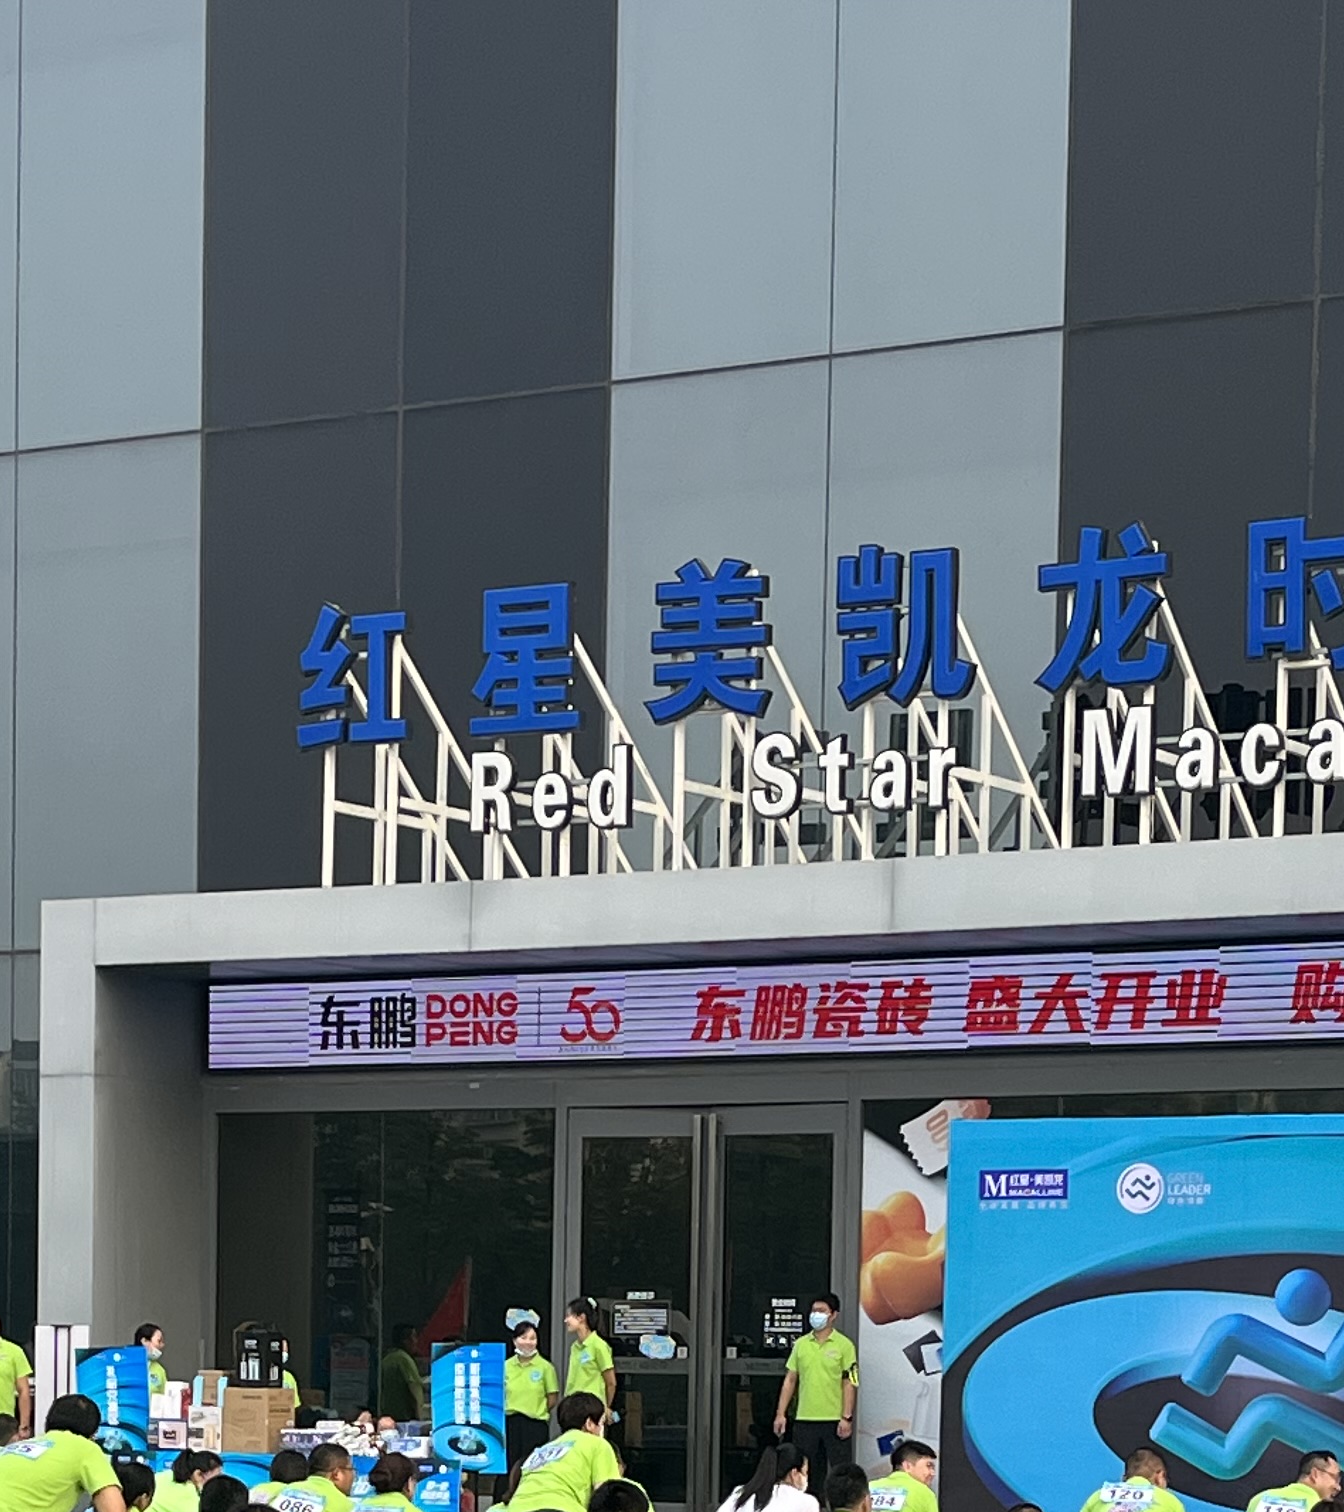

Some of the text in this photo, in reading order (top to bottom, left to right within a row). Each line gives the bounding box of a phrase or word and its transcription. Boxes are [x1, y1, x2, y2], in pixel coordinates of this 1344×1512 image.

[469, 742, 634, 836] Red
[750, 729, 960, 820] Star
[320, 993, 417, 1051] 东鹏
[424, 991, 519, 1020] DONG
[689, 977, 934, 1043] 东鹏瓷砖
[962, 967, 1228, 1035] 盛大开业
[424, 1020, 519, 1048] PENG
[1167, 1184, 1212, 1196] LEADER
